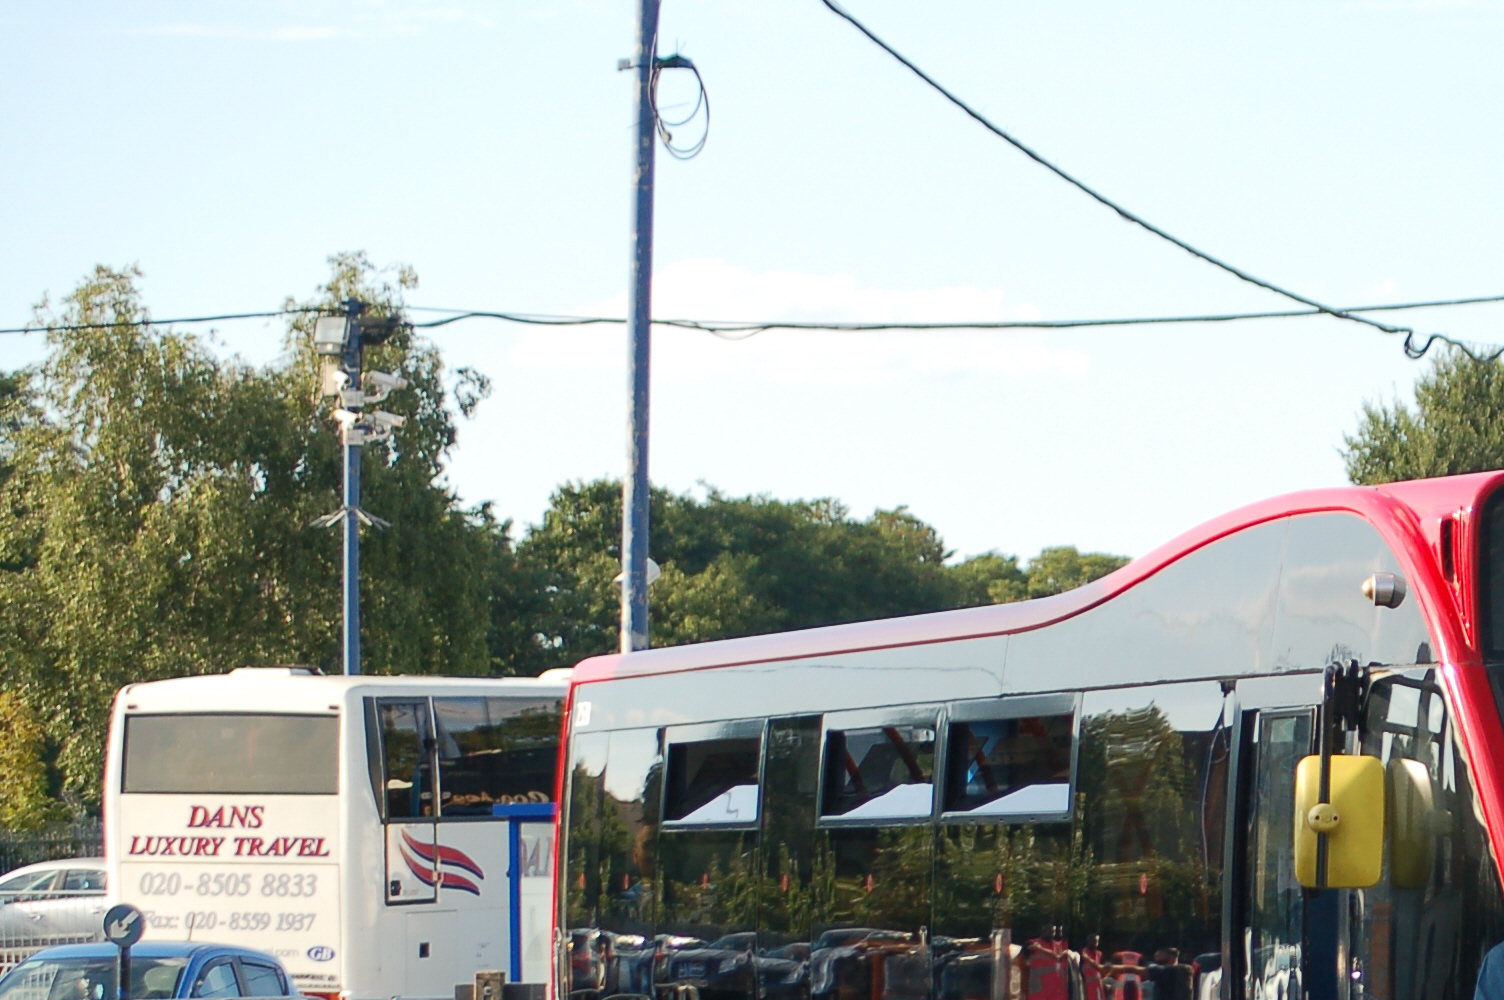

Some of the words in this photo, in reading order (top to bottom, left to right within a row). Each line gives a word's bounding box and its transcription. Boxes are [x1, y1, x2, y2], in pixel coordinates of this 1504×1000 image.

[187, 805, 265, 829] DANS
[129, 836, 226, 856] LUXURY
[233, 837, 330, 857] TRAVEL
[260, 873, 318, 897] 8833
[275, 912, 317, 931] 1937
[311, 947, 333, 961] GB
